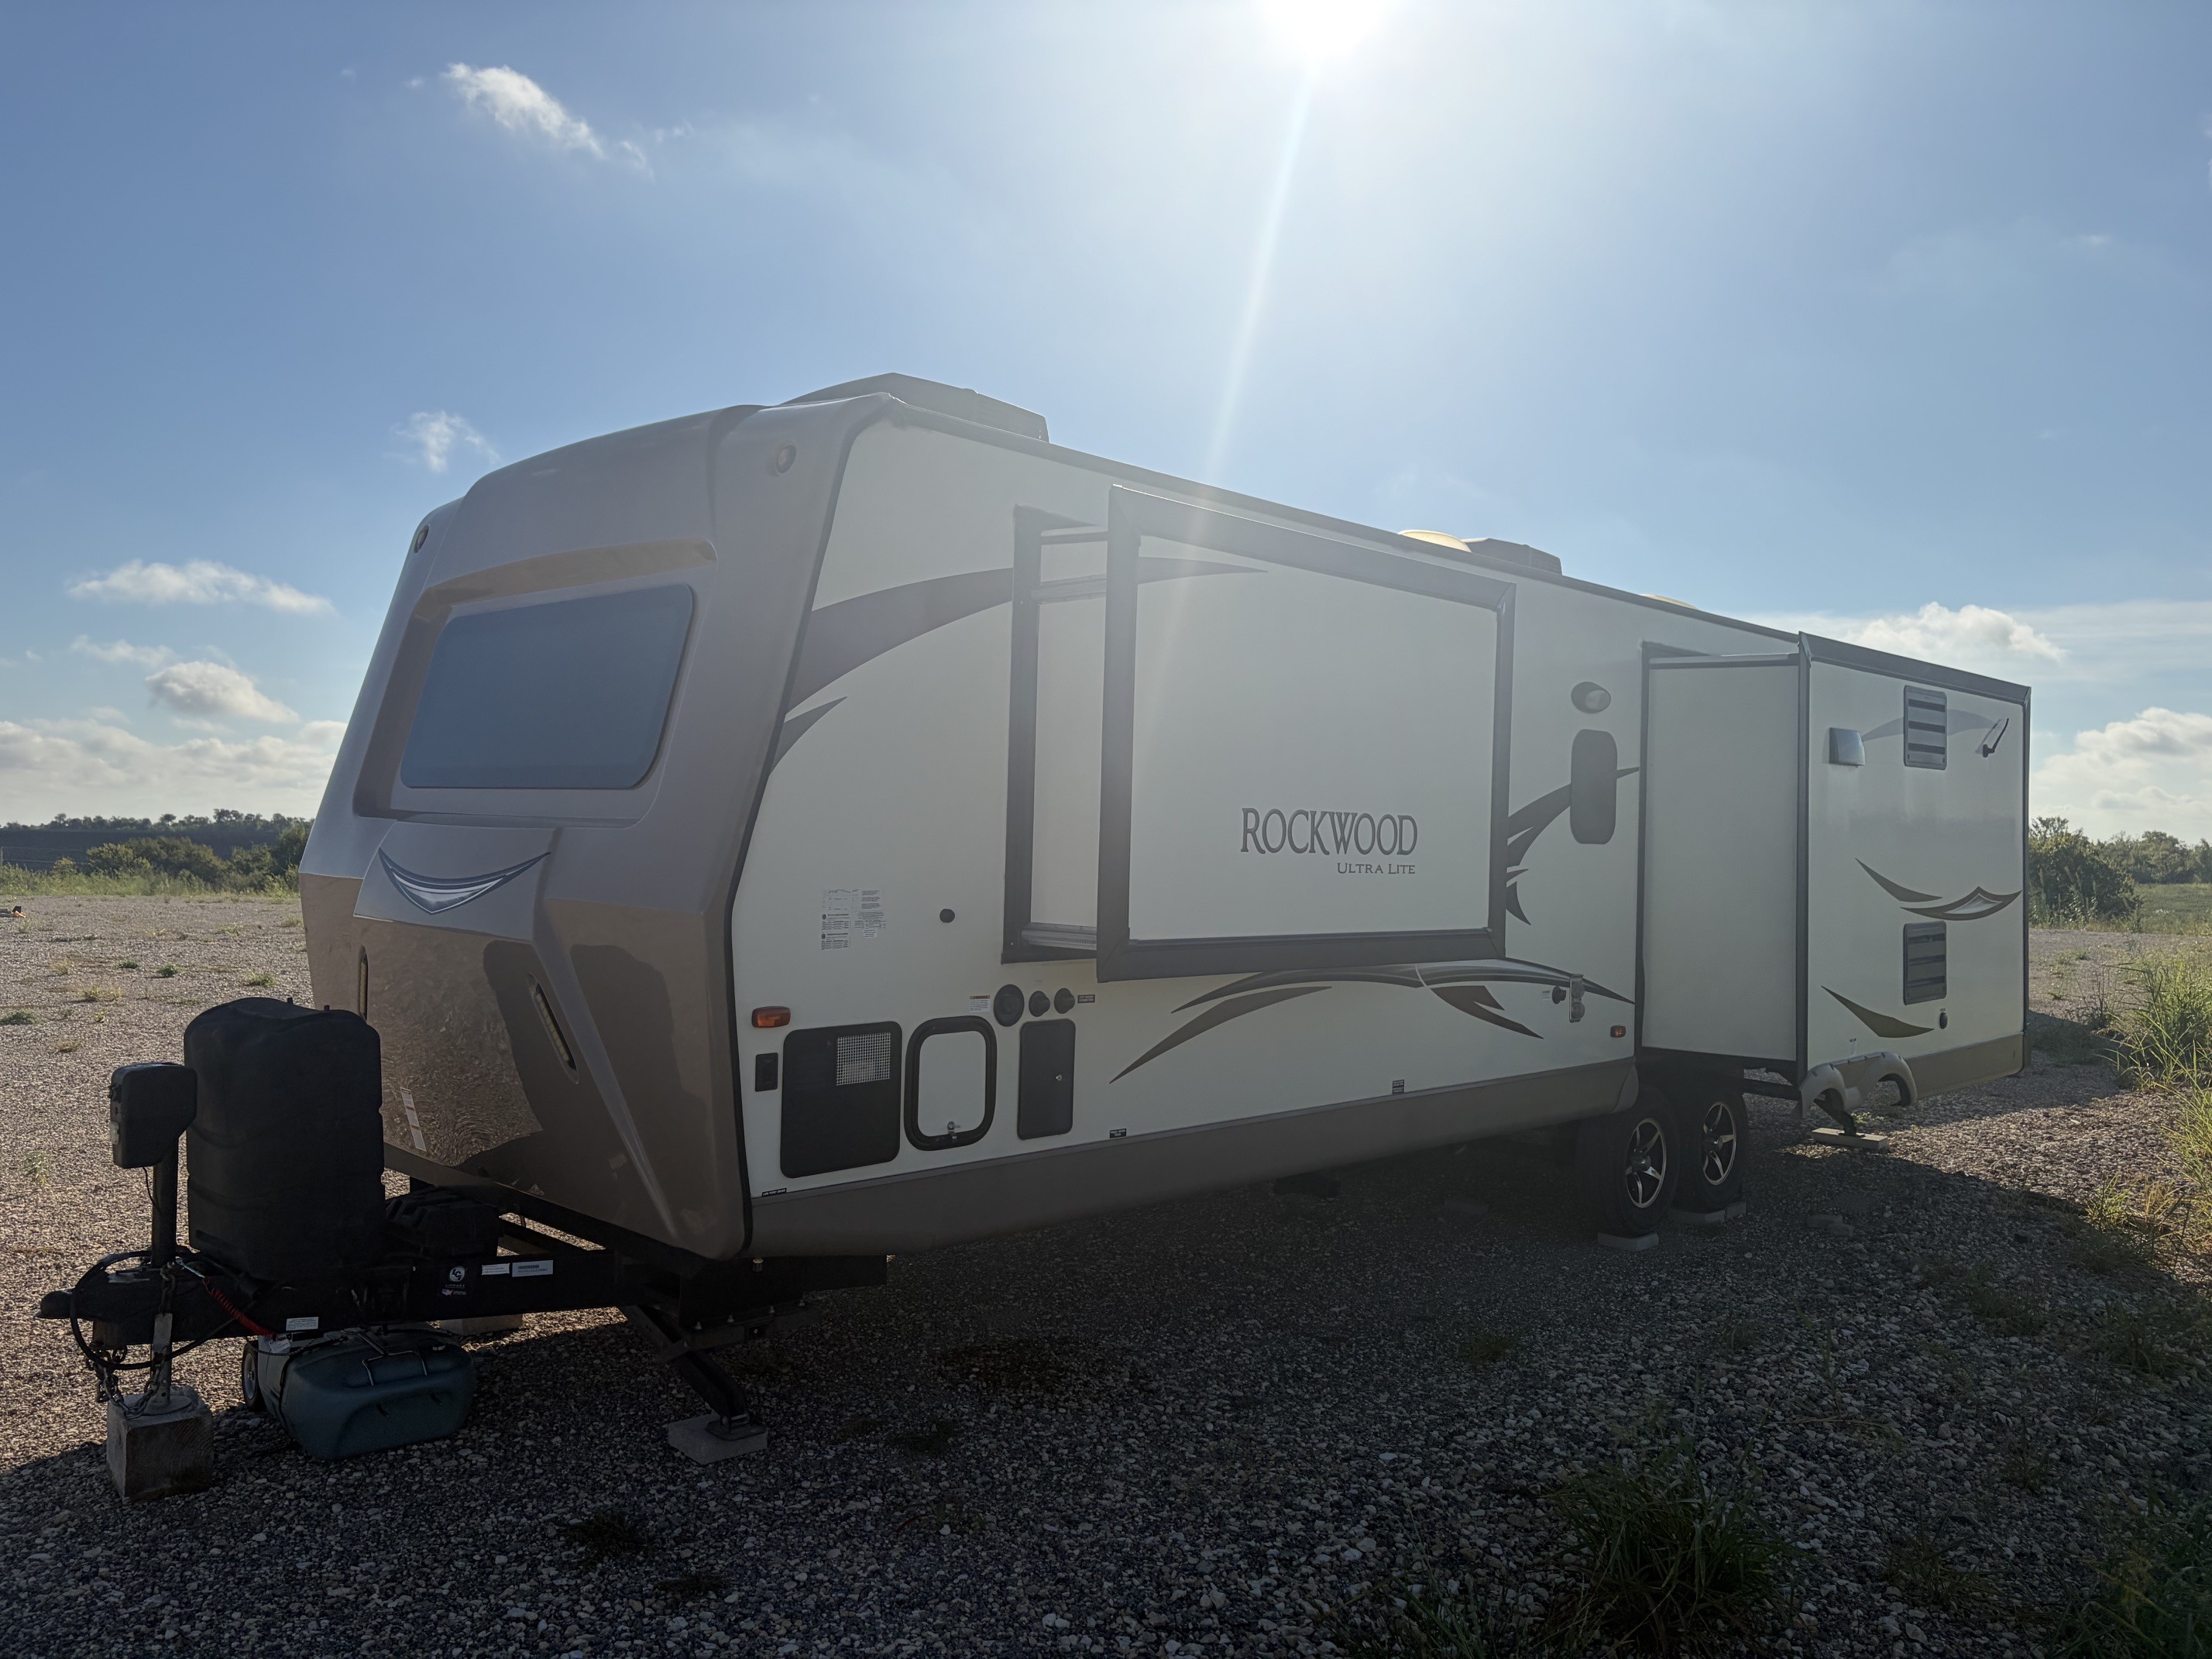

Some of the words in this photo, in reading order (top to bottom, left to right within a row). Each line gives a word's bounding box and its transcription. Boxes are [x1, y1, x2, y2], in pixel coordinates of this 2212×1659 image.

[1240, 808, 1417, 855] ROCKWOOD
[1337, 863, 1384, 874] ULTRA
[1388, 864, 1416, 874] LITE
